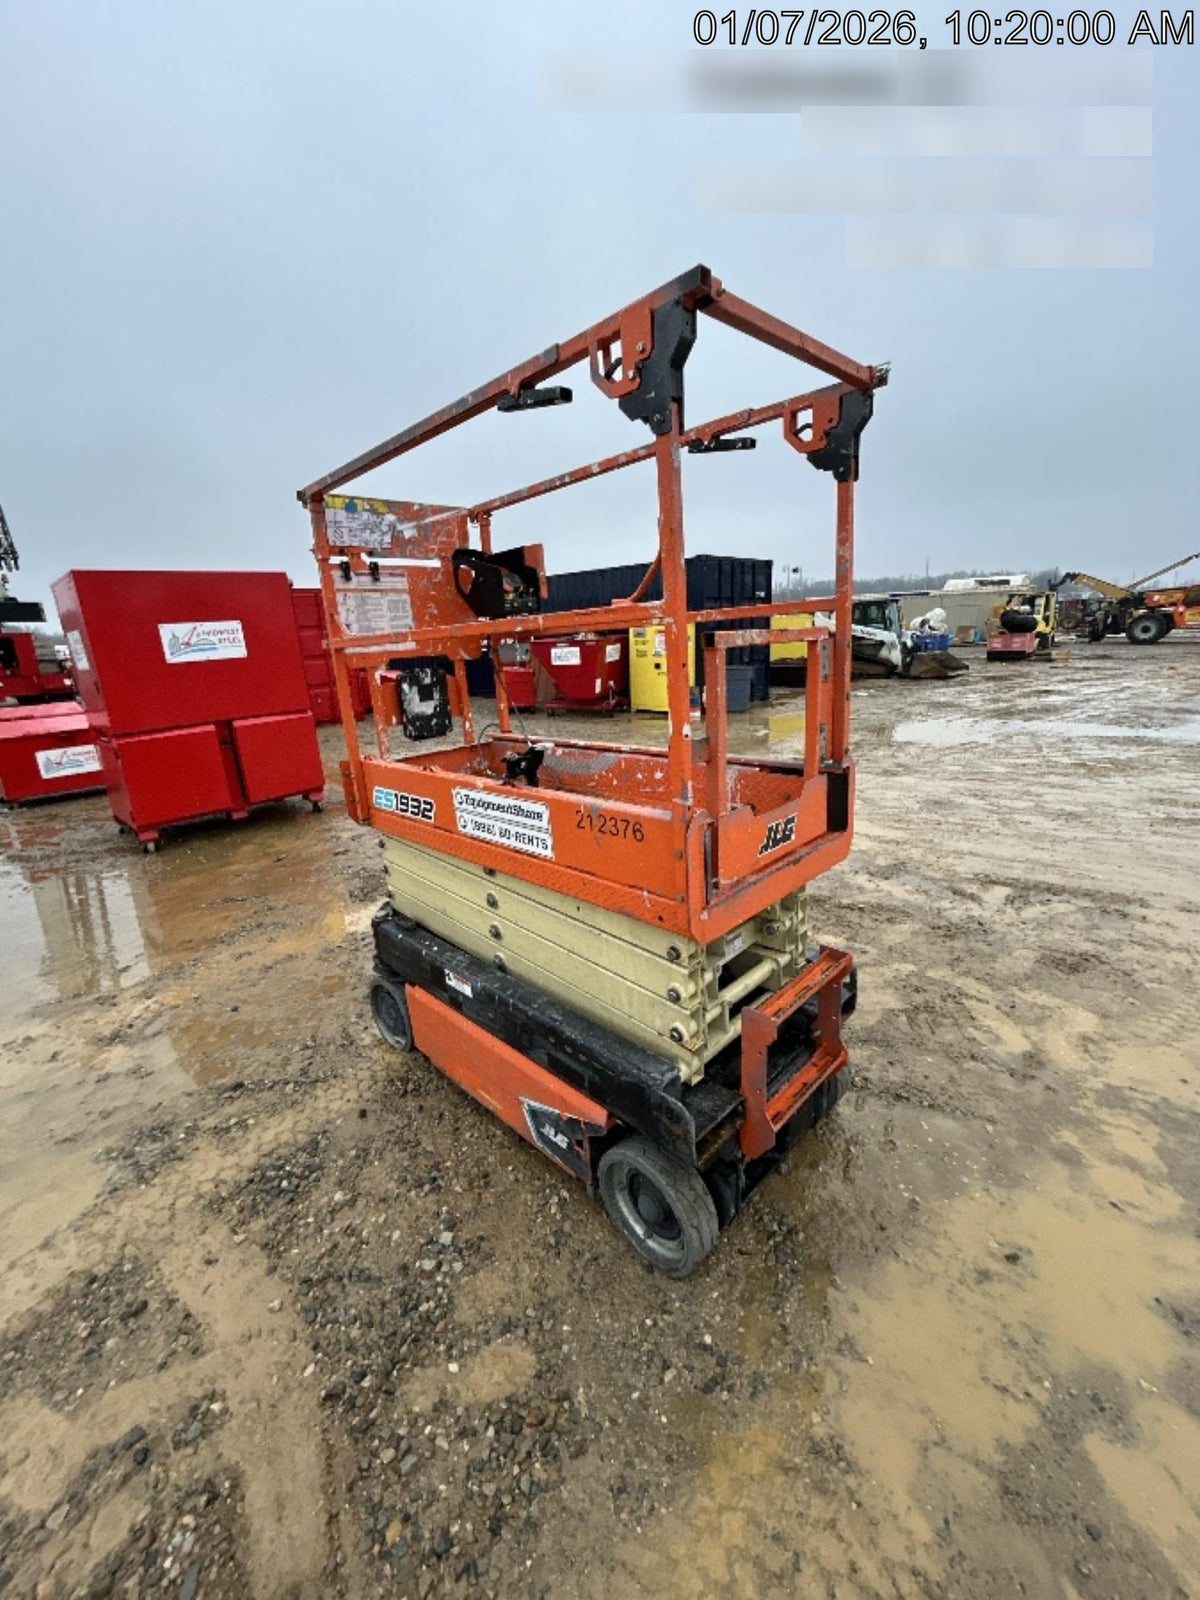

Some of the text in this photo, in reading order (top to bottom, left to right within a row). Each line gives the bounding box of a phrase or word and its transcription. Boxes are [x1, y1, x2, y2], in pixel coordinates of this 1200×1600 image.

[374, 788, 434, 820] ES1932
[575, 809, 645, 842] 212376
[758, 814, 797, 856] JLG
